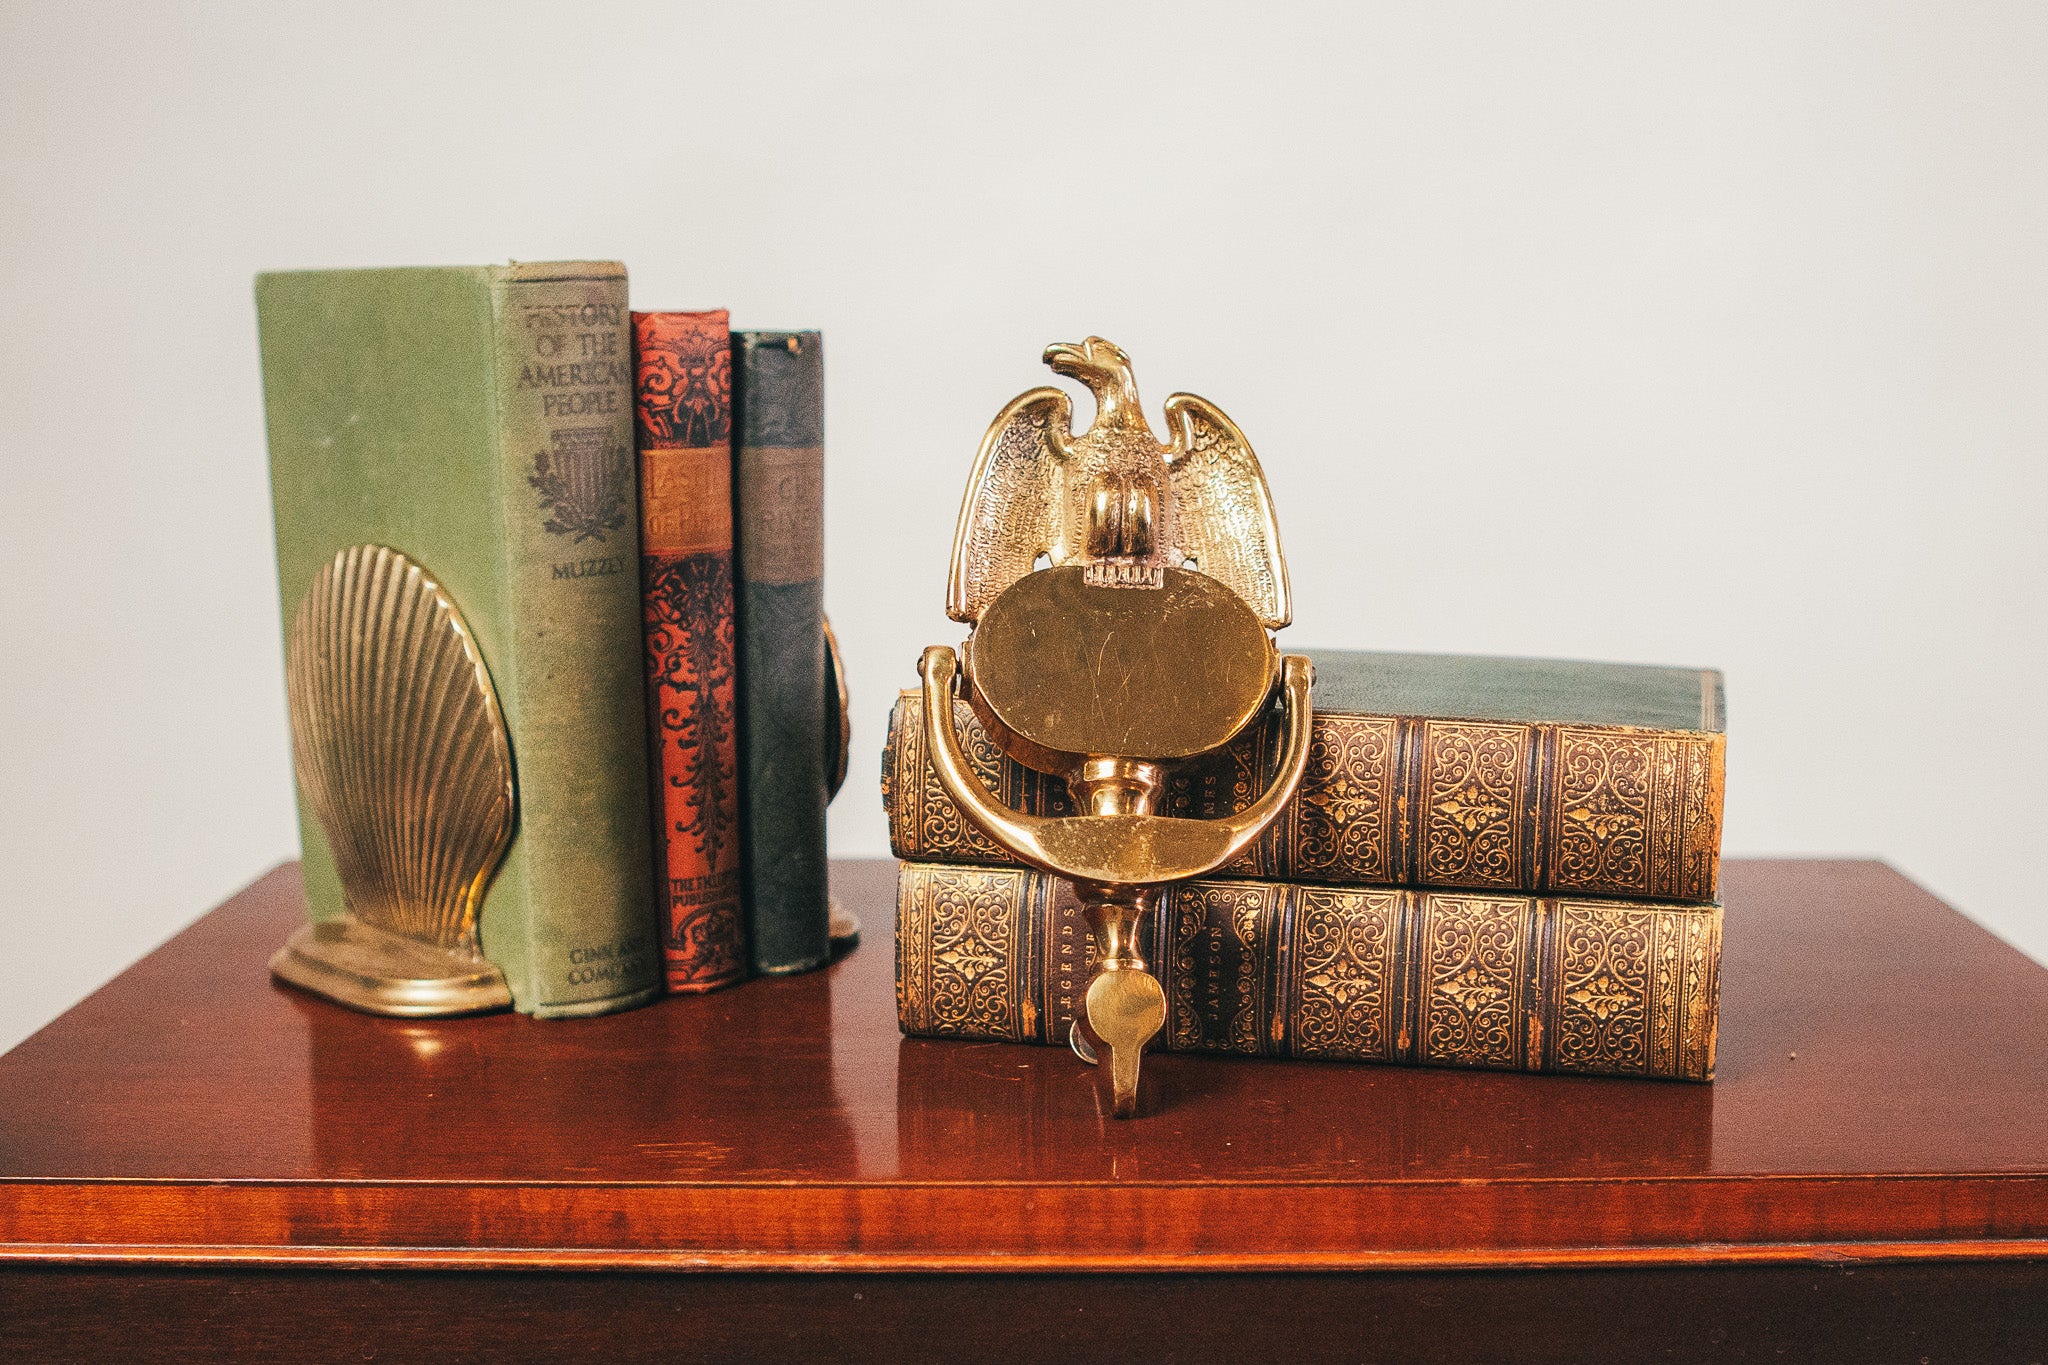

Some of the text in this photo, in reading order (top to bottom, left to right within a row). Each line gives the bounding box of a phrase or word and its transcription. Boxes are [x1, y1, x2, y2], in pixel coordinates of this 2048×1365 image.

[536, 332, 617, 358] OF THE
[516, 361, 630, 390] AMERICAN
[542, 391, 619, 417] PEOPLE
[552, 554, 626, 581] MUZZEY
[1060, 907, 1075, 1021] LEGENDS
